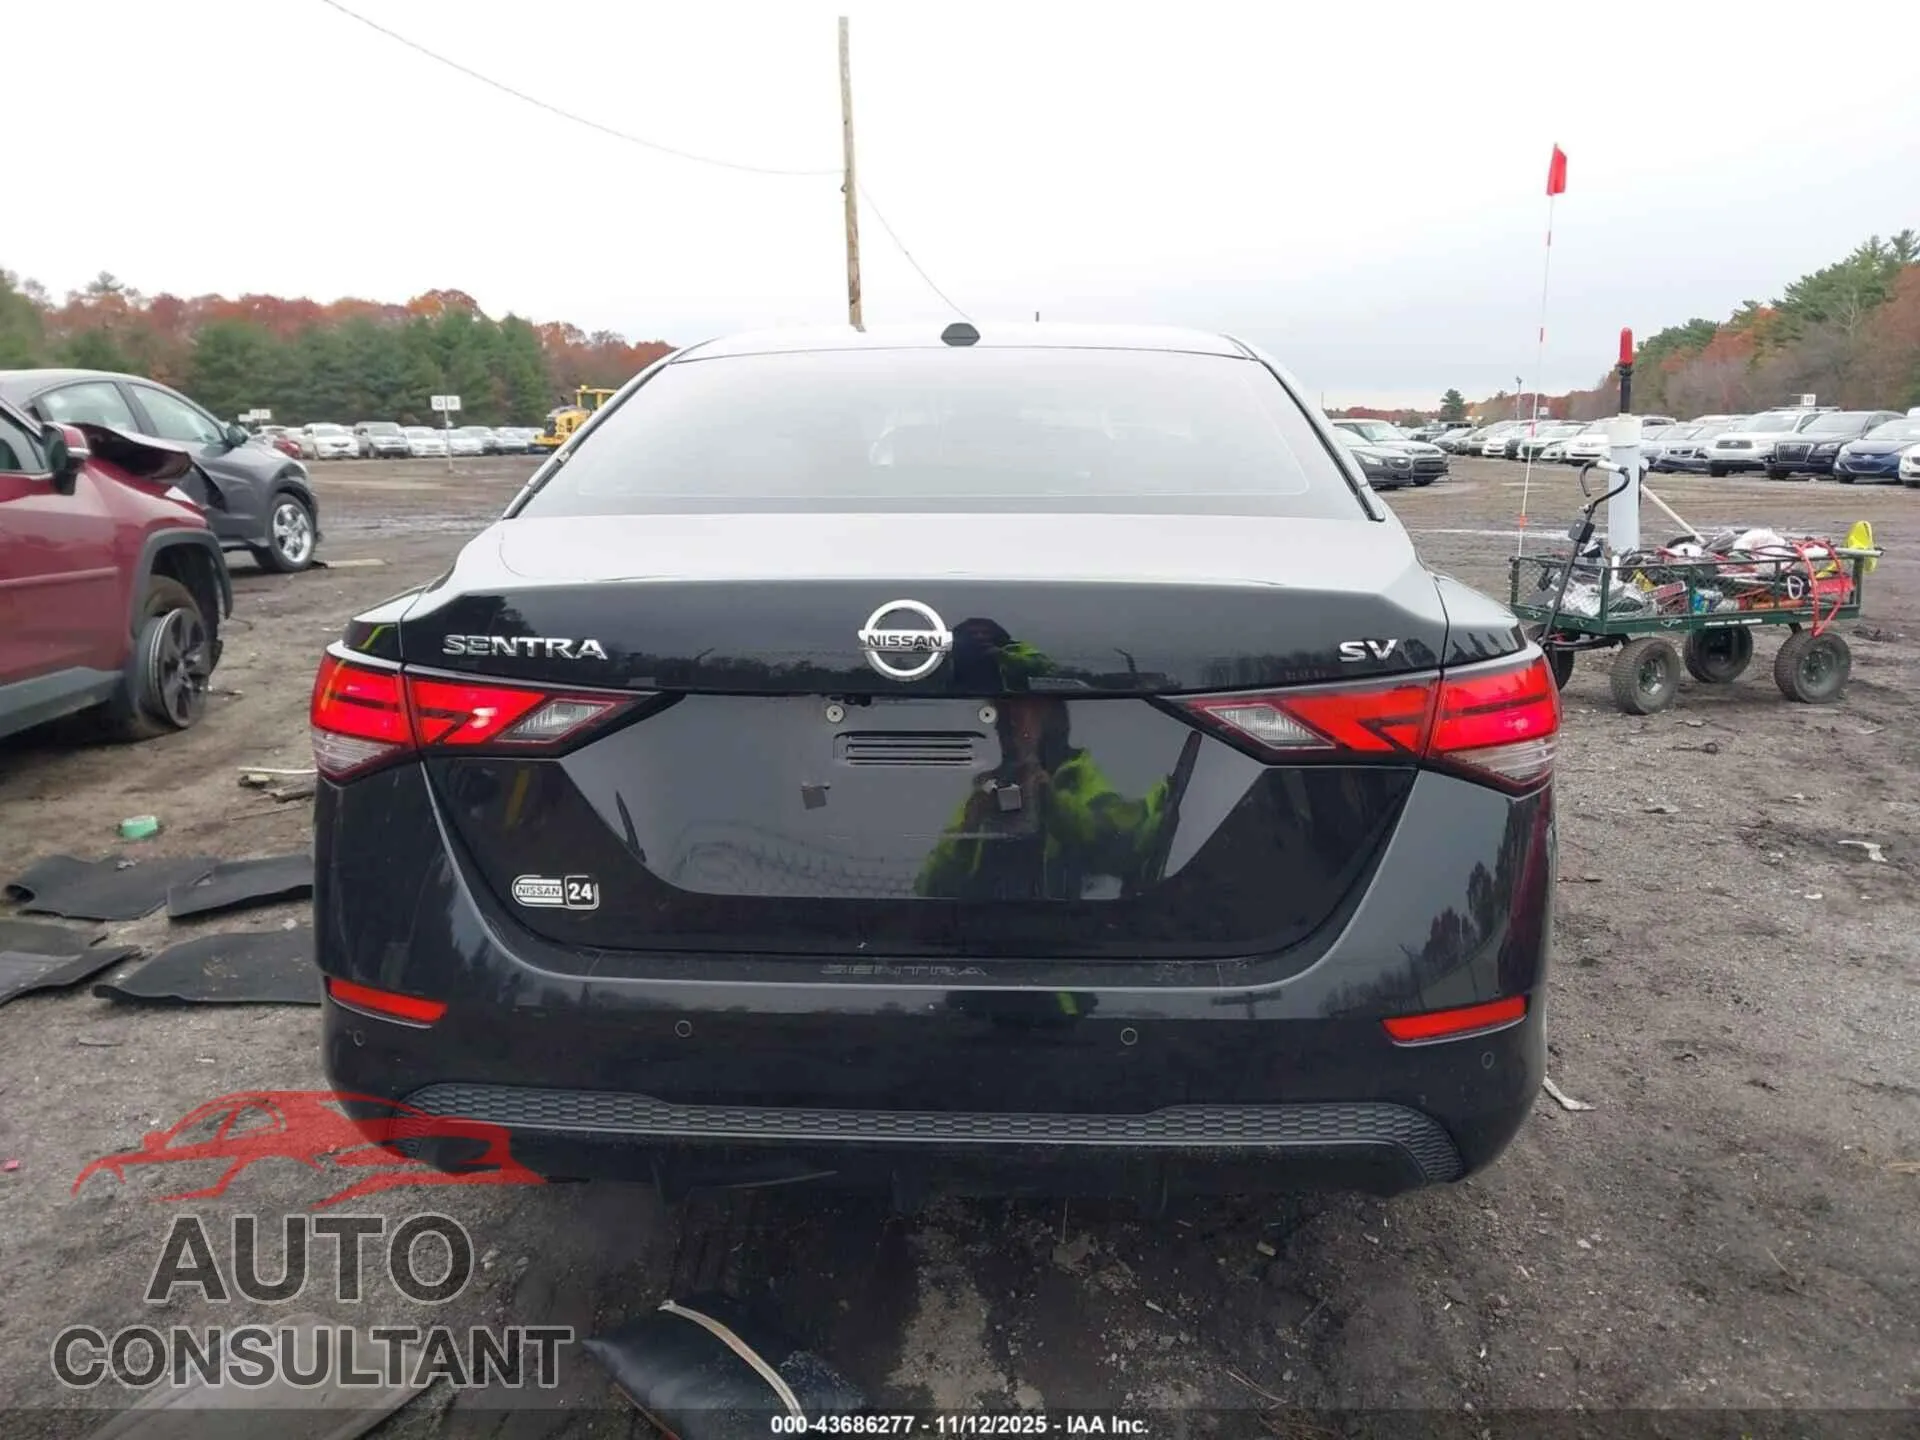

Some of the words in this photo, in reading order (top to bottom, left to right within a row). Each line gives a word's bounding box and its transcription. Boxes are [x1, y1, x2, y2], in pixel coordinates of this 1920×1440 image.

[442, 634, 608, 661] SENTRA
[867, 634, 942, 648] NISSAN
[1338, 638, 1399, 662] SV
[517, 885, 561, 896] NISSAN
[567, 882, 593, 901] 24
[820, 964, 988, 977] SENTRA
